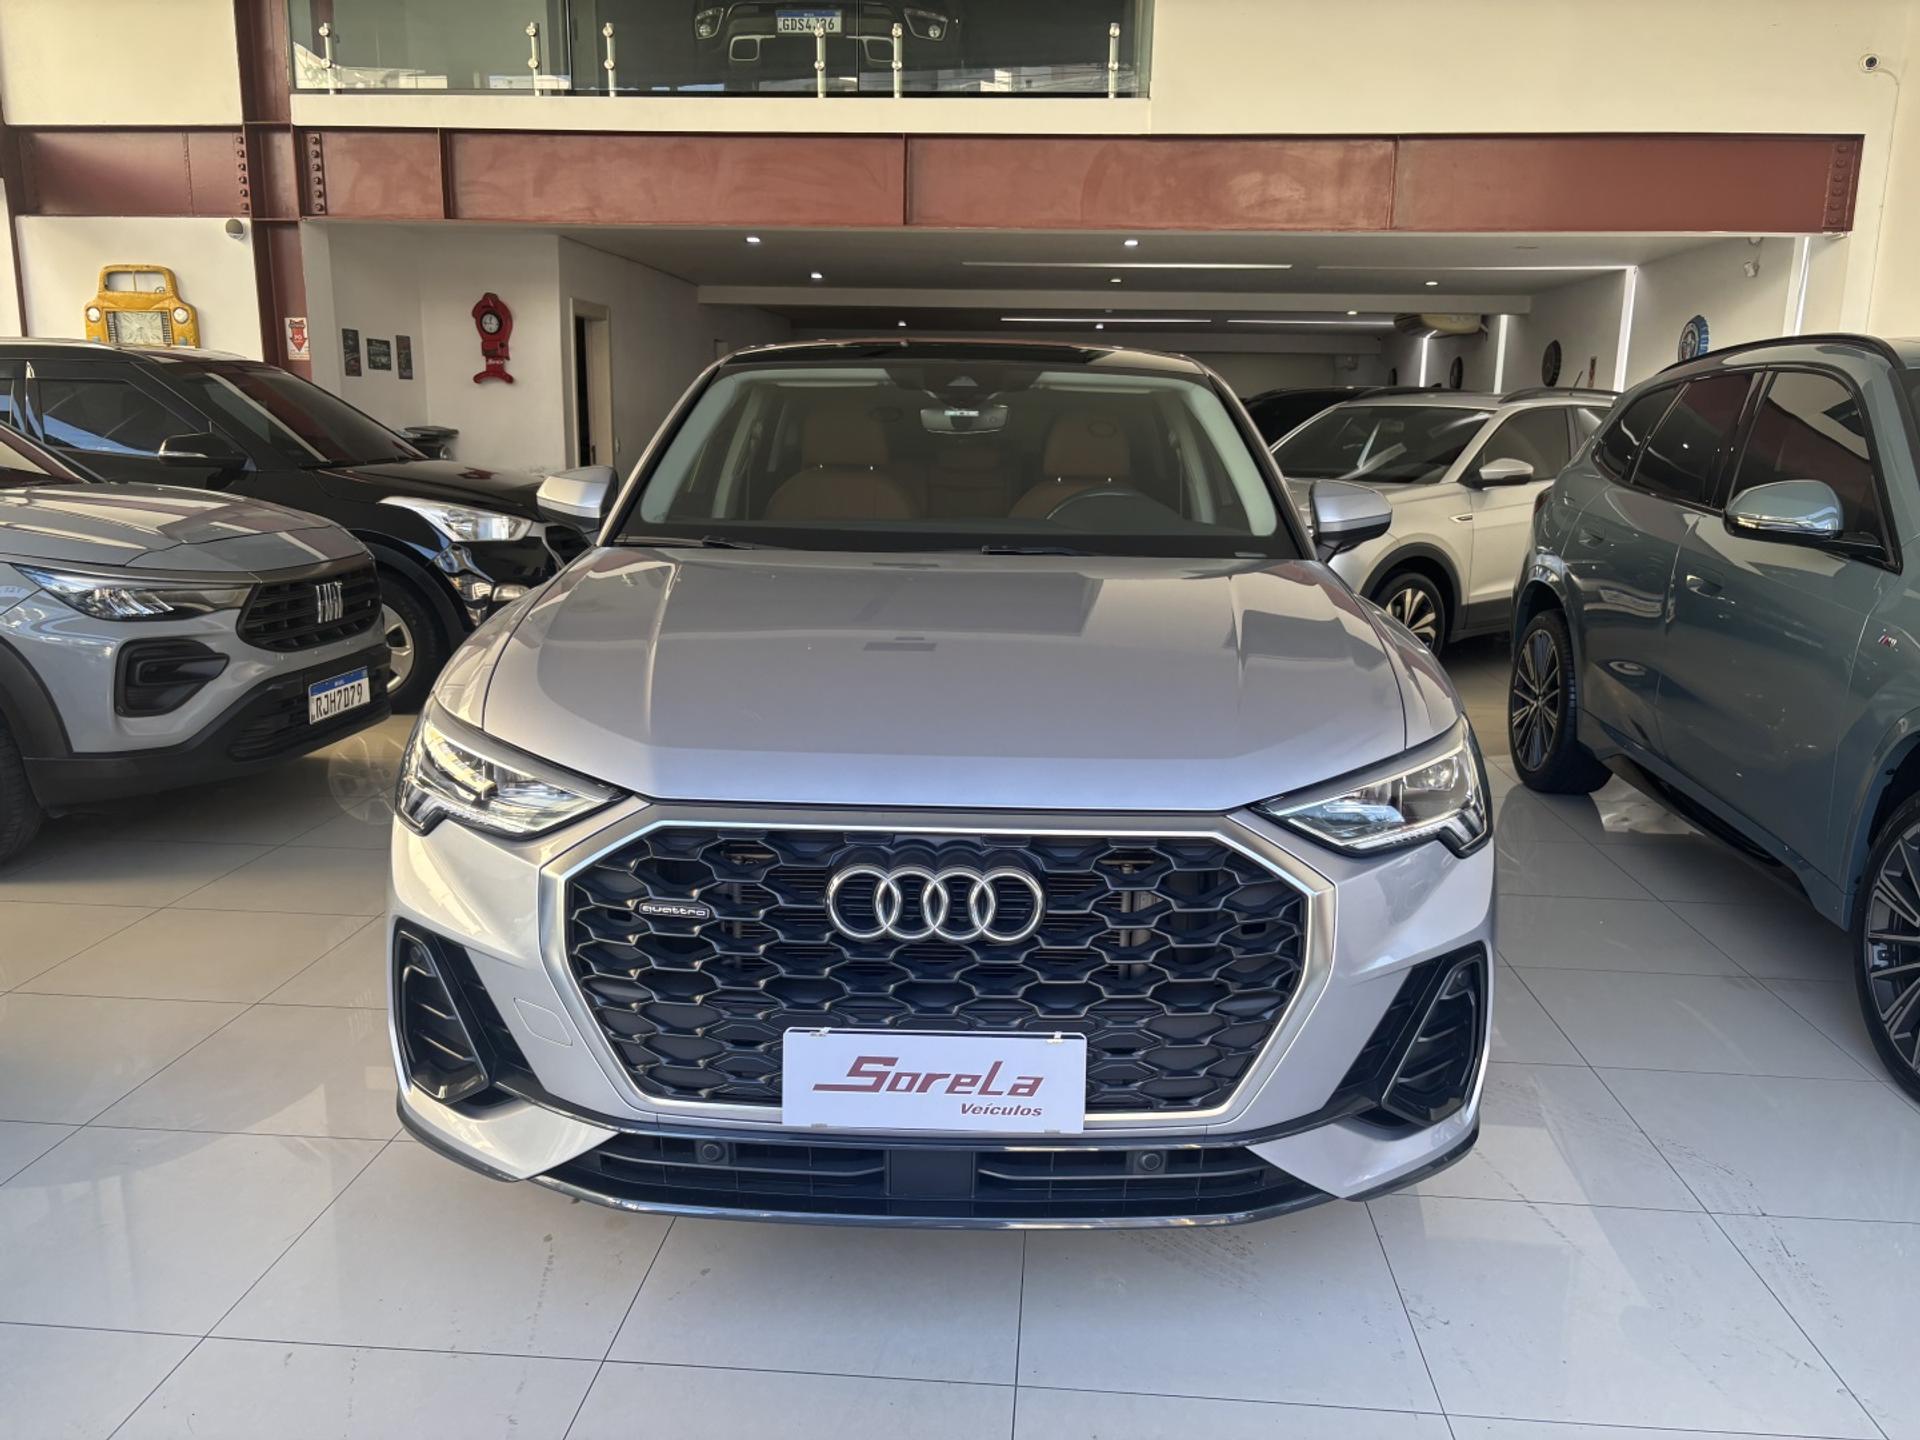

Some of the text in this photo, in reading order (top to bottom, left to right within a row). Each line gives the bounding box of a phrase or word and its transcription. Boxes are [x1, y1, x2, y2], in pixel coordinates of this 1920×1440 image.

[782, 18, 835, 31] GDS46
[315, 682, 363, 719] RJH7D79
[642, 905, 706, 916] quattro
[960, 1102, 1043, 1117] Veículos
